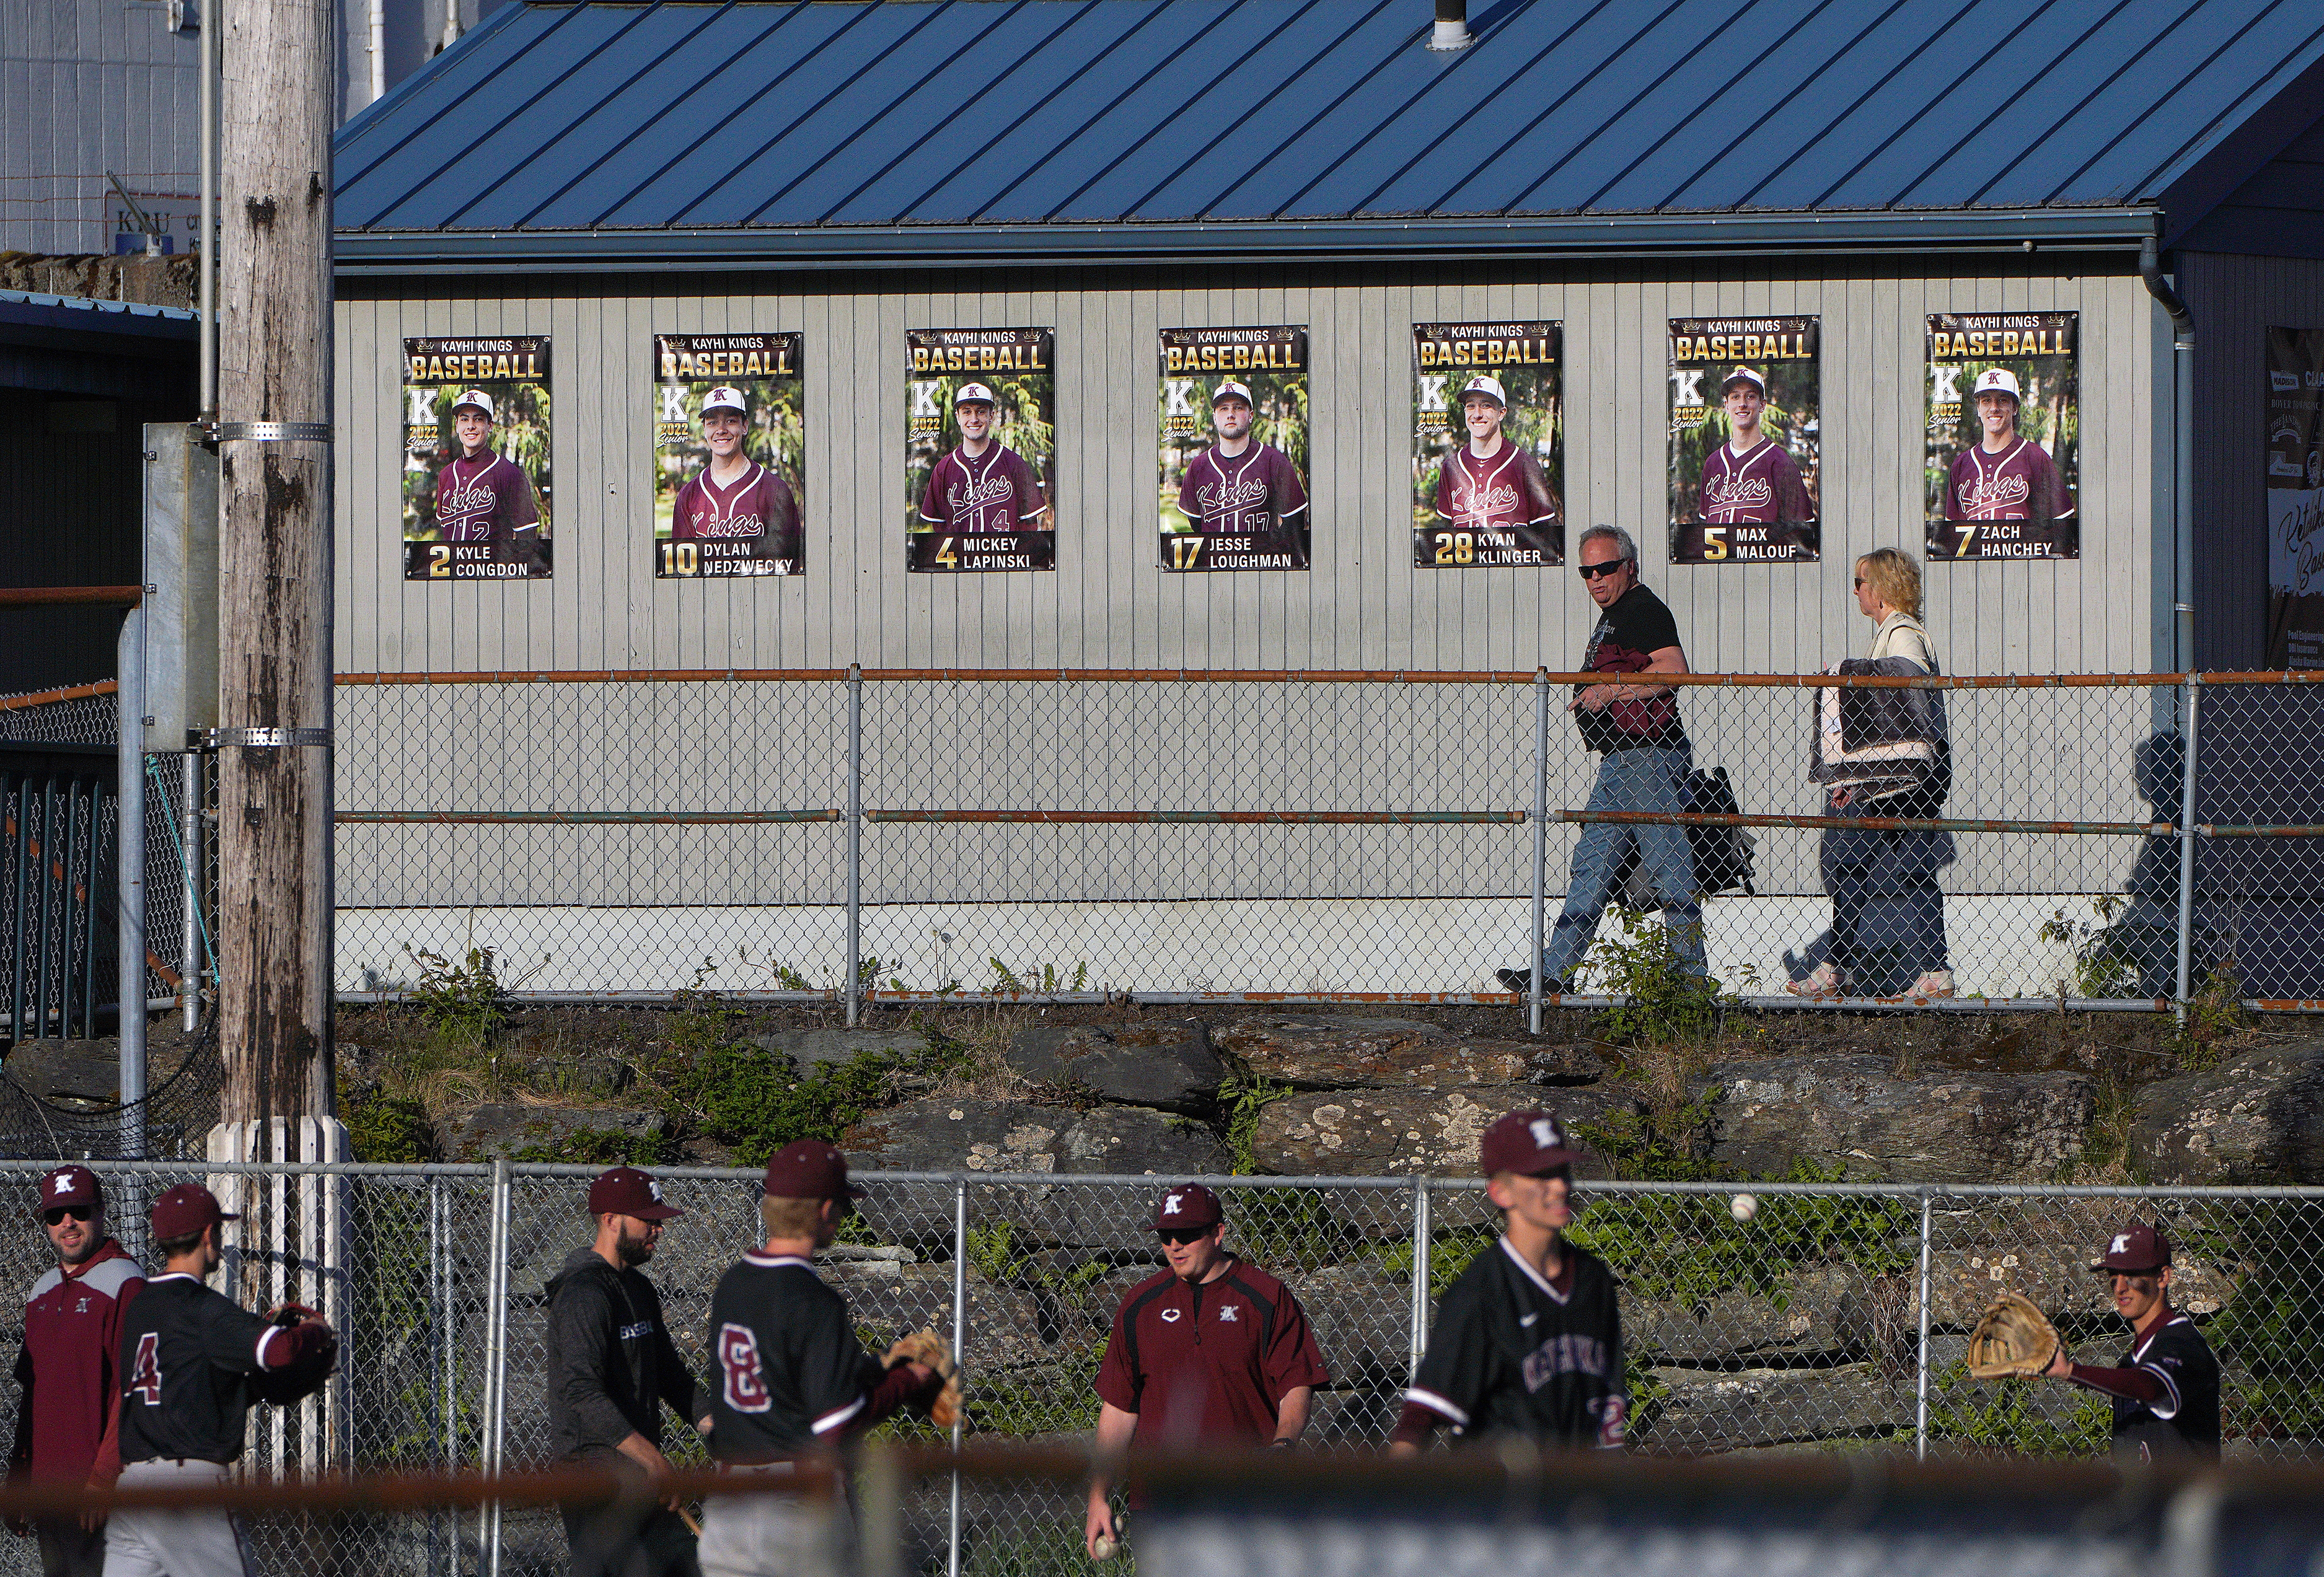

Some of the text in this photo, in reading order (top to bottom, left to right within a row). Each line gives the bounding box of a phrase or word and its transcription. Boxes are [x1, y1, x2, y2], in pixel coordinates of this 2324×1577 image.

[1708, 321, 1780, 333] KAYHI KINGS
[1966, 316, 2039, 329] KAYHI KINGS
[944, 332, 1016, 344] KAYHI KINGS
[1198, 330, 1269, 343] KAYHI KINGS
[1451, 326, 1523, 338] KAYHI KINGS
[441, 340, 513, 353] KAYHI KINGS
[692, 337, 764, 350] KAYHI KINGS
[1677, 335, 1811, 361] BASEBALL
[1935, 330, 2071, 356] BASEBALL
[914, 346, 1046, 372] BASEBALL
[1168, 345, 1300, 371] BASEBALL
[1420, 340, 1554, 367] BASEBALL
[412, 355, 542, 380] BASEBALL
[662, 351, 793, 377] BASEBALL
[1675, 369, 1704, 406] K
[1933, 366, 1961, 403] K
[913, 380, 941, 417] K
[1166, 380, 1194, 416] K
[1420, 376, 1448, 411] K
[410, 389, 439, 425] K
[661, 385, 689, 422] K
[1932, 404, 1961, 416] 2022
[1419, 412, 1447, 424] 2022
[1675, 407, 1703, 420] 2022
[912, 418, 940, 430] 2022
[1166, 418, 1194, 429] 2022
[1670, 418, 1704, 433] Senior
[1927, 415, 1961, 429] Senior
[410, 426, 438, 438] 2022
[661, 424, 688, 435] 2022
[907, 429, 940, 442] Senior
[1161, 428, 1194, 442] Senior
[1414, 423, 1448, 437] Senior
[405, 437, 438, 450] Senior
[656, 434, 689, 448] Senior
[948, 475, 1013, 511] Kings
[1197, 478, 1267, 512] Kings
[1706, 473, 1771, 507] Kings
[1958, 474, 2028, 513] Kings
[441, 485, 496, 517] Kings
[1452, 485, 1518, 513] Kings
[692, 512, 764, 537] Kings
[1736, 529, 1767, 541] MAX
[1981, 526, 2020, 539] ZACH
[964, 538, 1018, 551] MICKEY
[1210, 538, 1251, 551] JESSE
[1479, 534, 1515, 547] KYAN
[1704, 527, 1726, 560] 5
[1955, 526, 1976, 557] 7
[456, 547, 490, 560] KYLE
[704, 543, 750, 556] DYLAN
[935, 537, 957, 569] 4
[1171, 537, 1204, 569] 17
[1436, 533, 1472, 564] 28
[1736, 545, 1797, 558] MALOUF
[1981, 543, 2052, 556] HANCHEY
[429, 546, 451, 577] 2
[662, 543, 697, 575] 10
[964, 555, 1030, 568] LAPINSKI
[1210, 555, 1291, 568] LOUGHMAN
[1479, 550, 1541, 563] KLINGER
[456, 563, 527, 576] CONGDON
[704, 560, 793, 574] NEDZWECKY
[125, 1332, 162, 1405] 4
